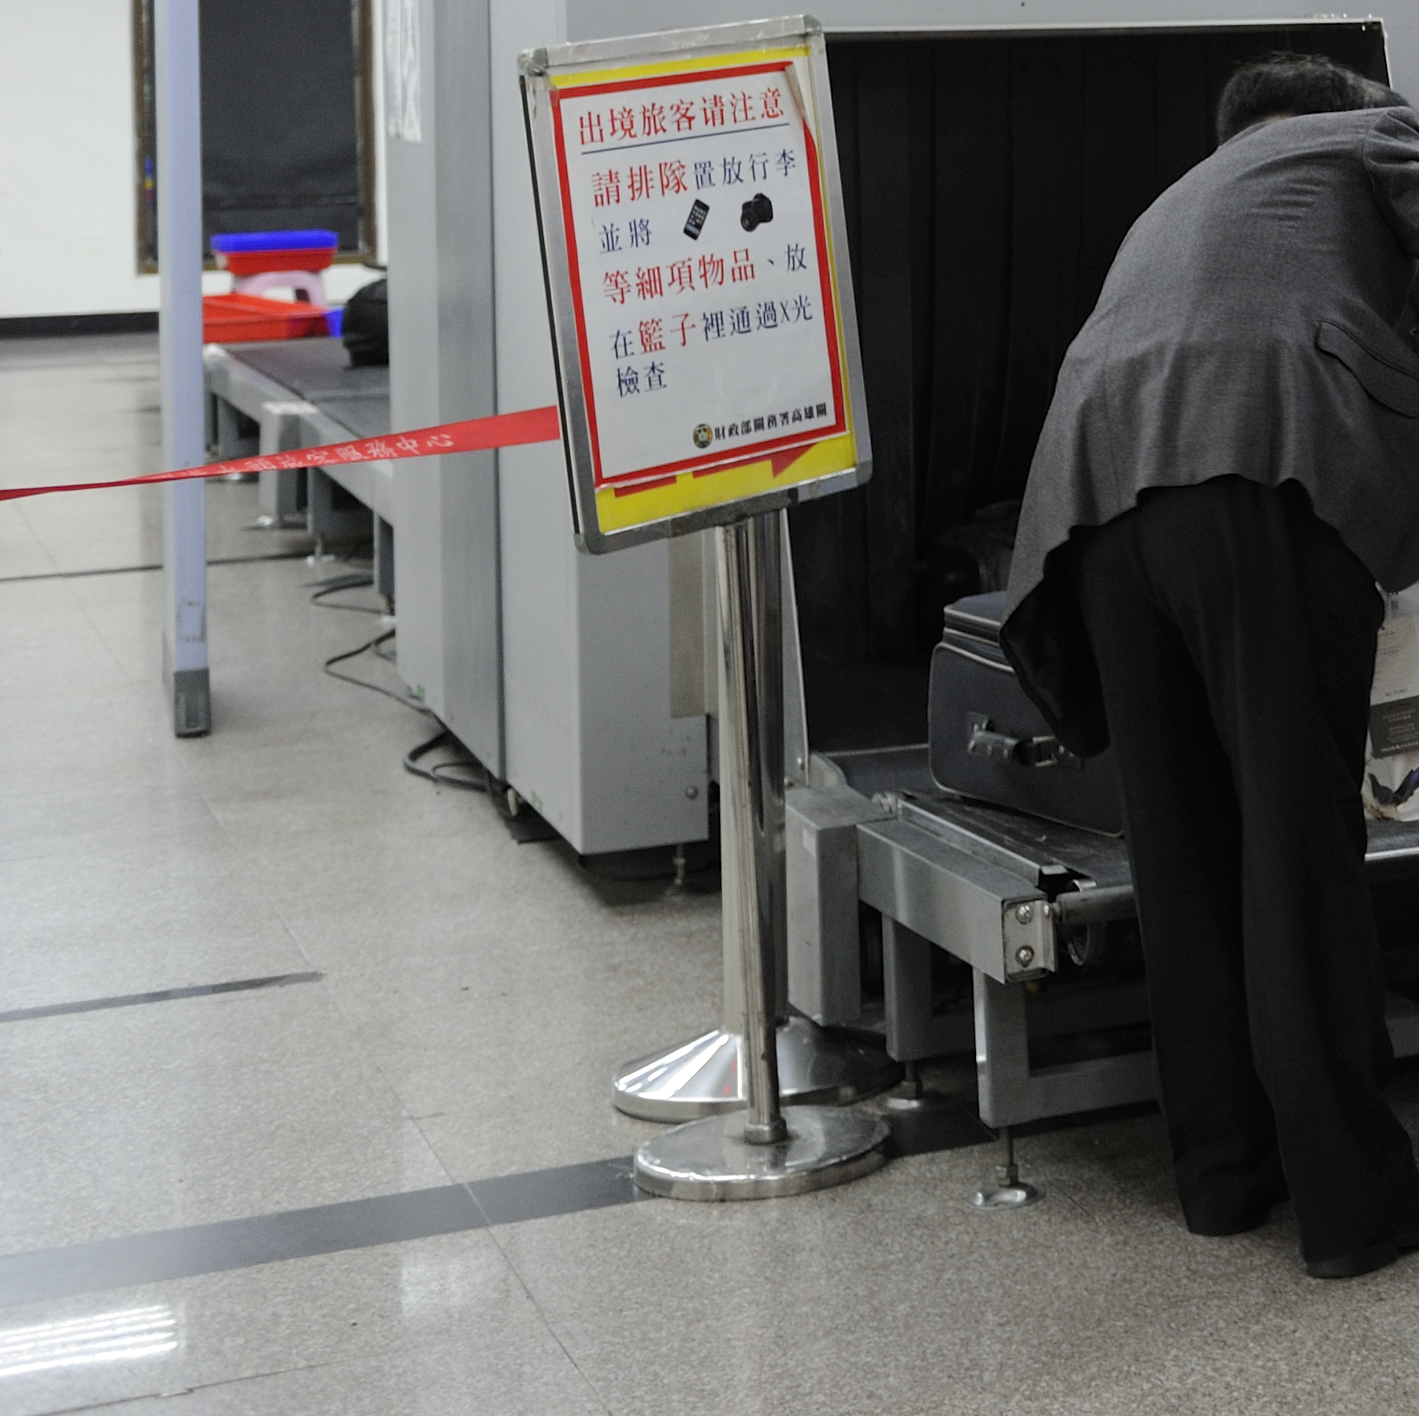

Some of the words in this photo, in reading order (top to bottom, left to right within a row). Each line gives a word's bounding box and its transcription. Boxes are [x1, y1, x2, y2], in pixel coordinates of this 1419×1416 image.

[579, 87, 785, 146] 出境旅客请注意
[591, 149, 796, 208] 請排隊置放行李
[599, 218, 652, 254] 並將
[616, 361, 667, 398] 檢查
